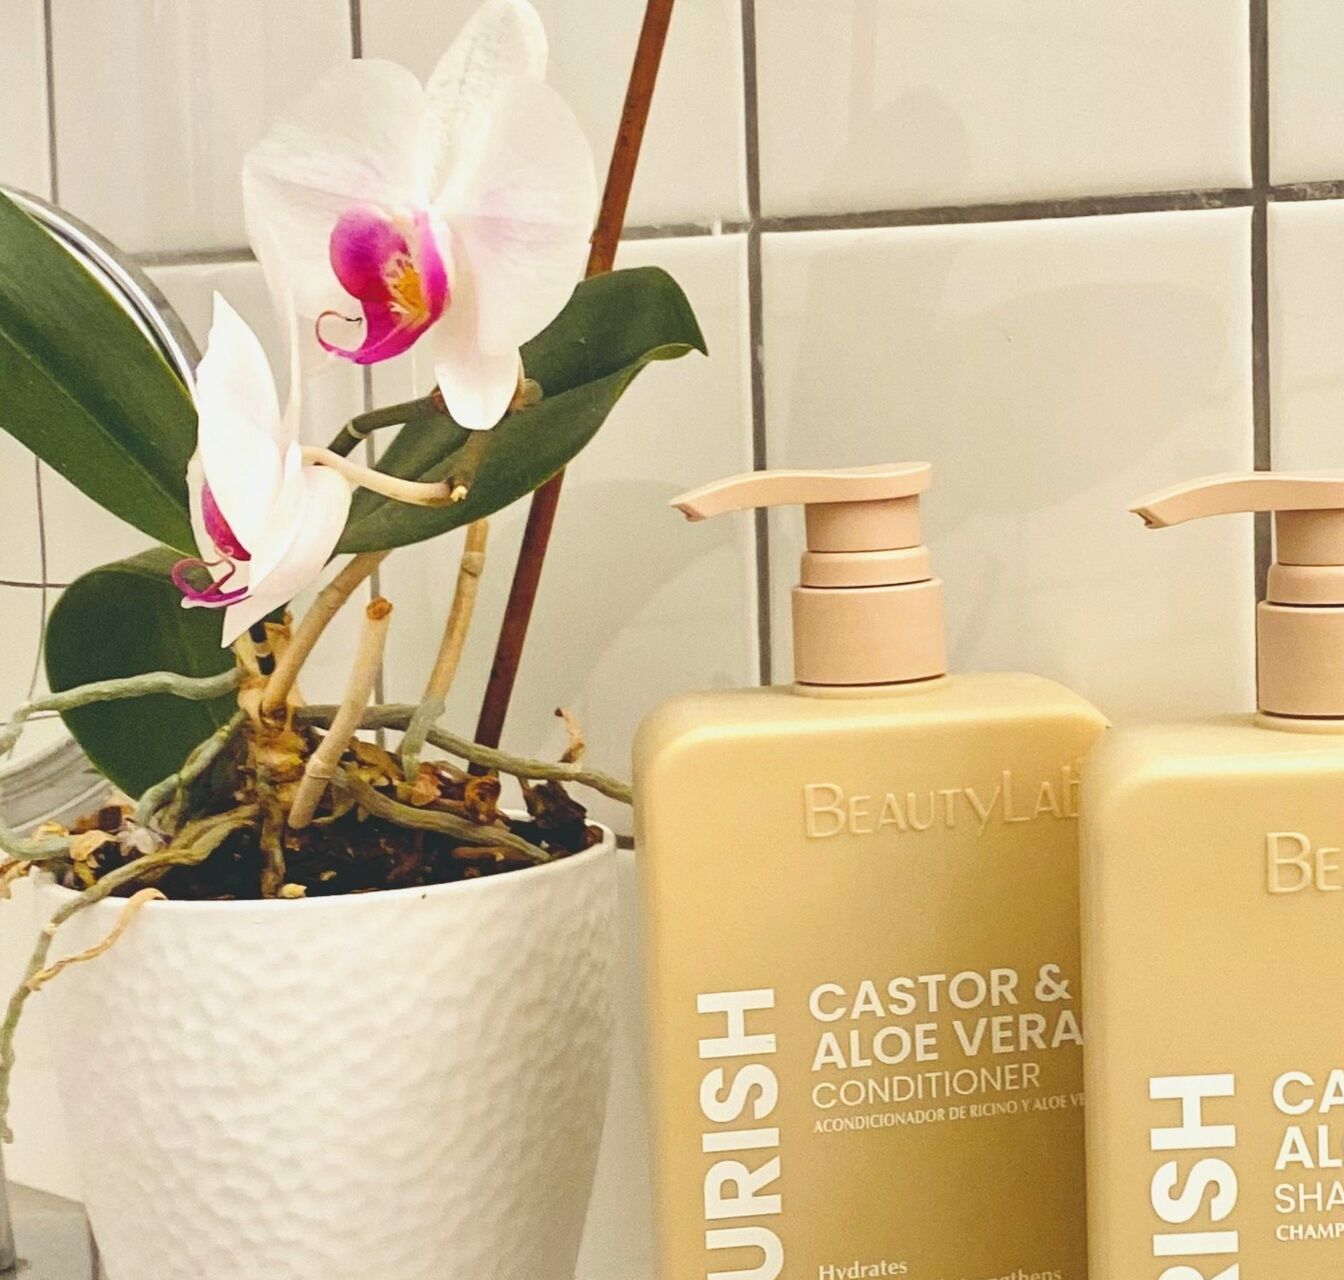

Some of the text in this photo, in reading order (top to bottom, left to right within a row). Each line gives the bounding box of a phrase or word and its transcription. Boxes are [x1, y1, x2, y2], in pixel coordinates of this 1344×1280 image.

[808, 962, 1073, 1022] CASTOR &
[810, 1008, 1084, 1072] ALOE VERA
[811, 1062, 1041, 1110] CONDITIONER
[812, 1107, 946, 1134] ACONDICIONADOR
[948, 1105, 968, 1121] DE
[970, 1099, 1018, 1119] RICINO
[1021, 1099, 1031, 1113] Y
[1032, 1094, 1067, 1112] ALOE
